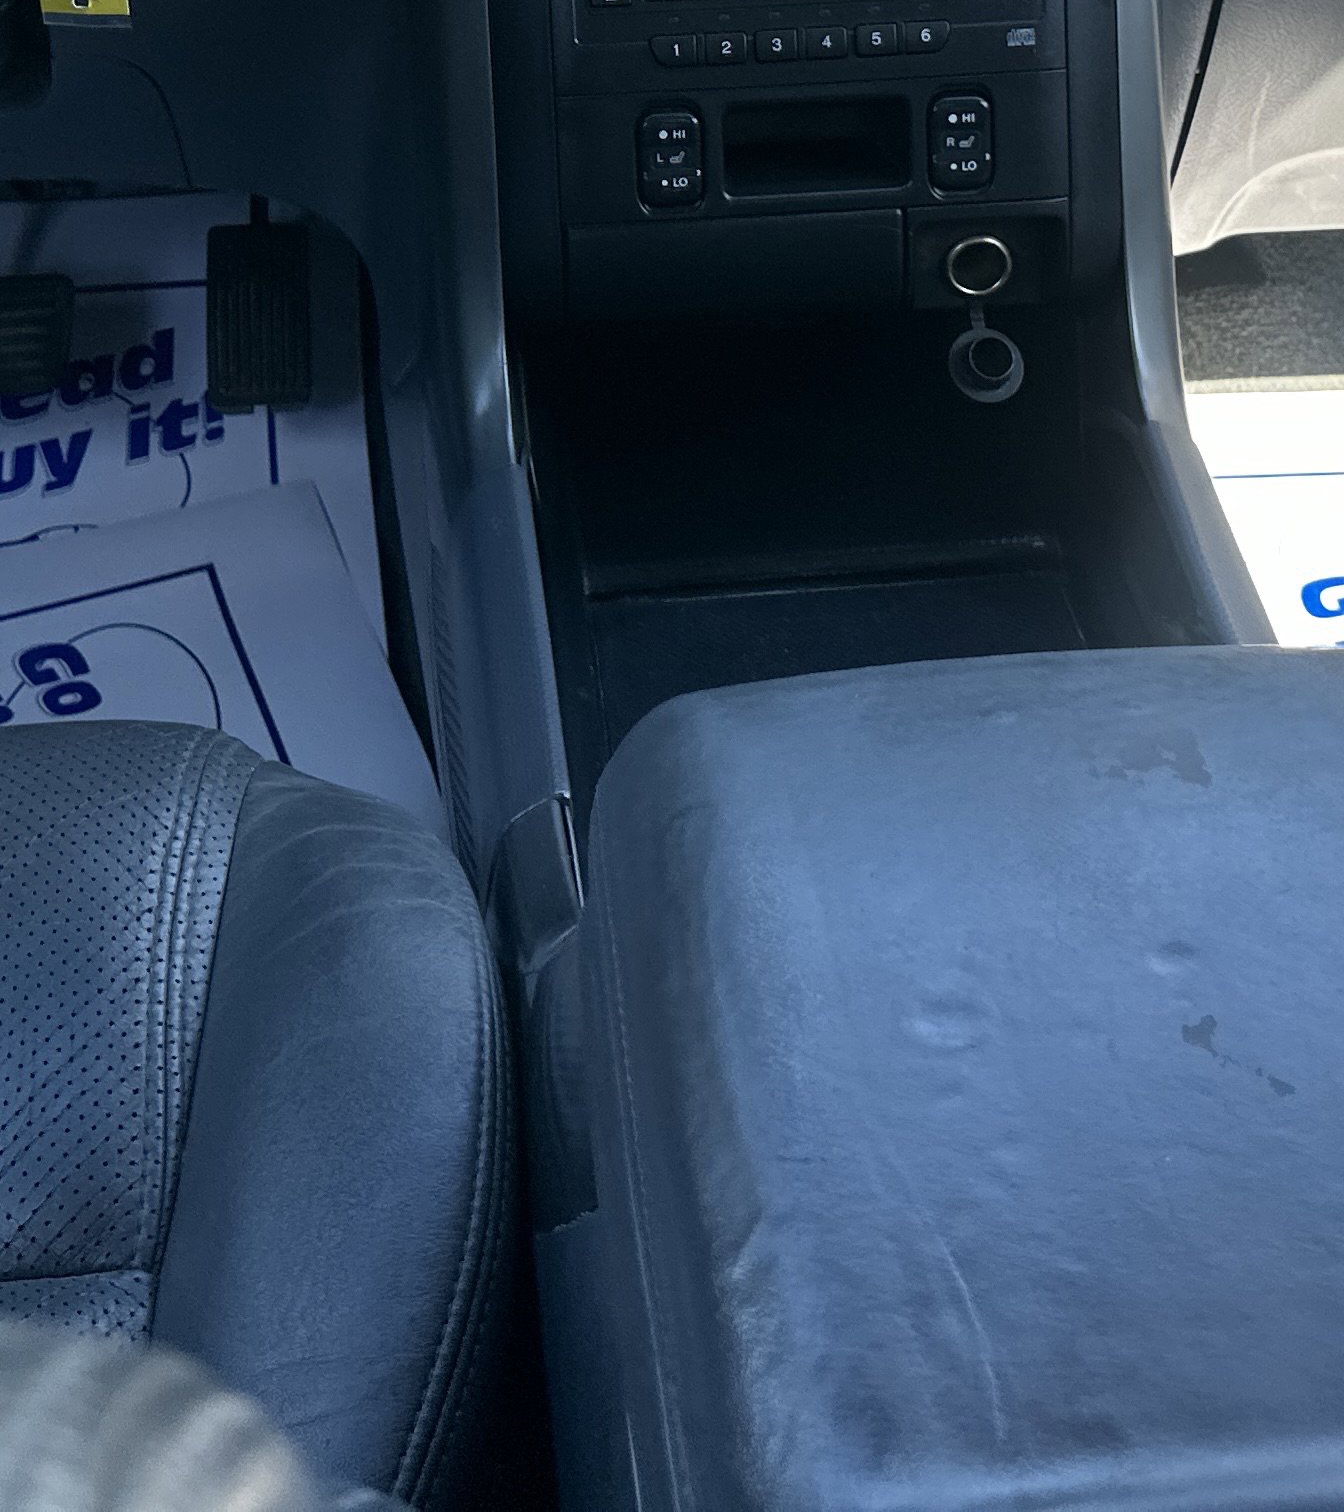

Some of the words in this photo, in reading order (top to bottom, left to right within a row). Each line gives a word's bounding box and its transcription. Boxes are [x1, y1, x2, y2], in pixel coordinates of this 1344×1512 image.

[821, 34, 832, 48] 4
[871, 31, 882, 45] 5
[920, 28, 931, 42] 6
[673, 43, 680, 56] 1
[721, 41, 732, 54] 2
[771, 37, 782, 51] 3
[961, 112, 976, 123] HI
[672, 129, 686, 139] HI
[946, 136, 955, 147] R
[656, 152, 664, 163] L
[961, 160, 977, 172] LO
[672, 176, 689, 188] LO
[13, 642, 103, 717] Go
